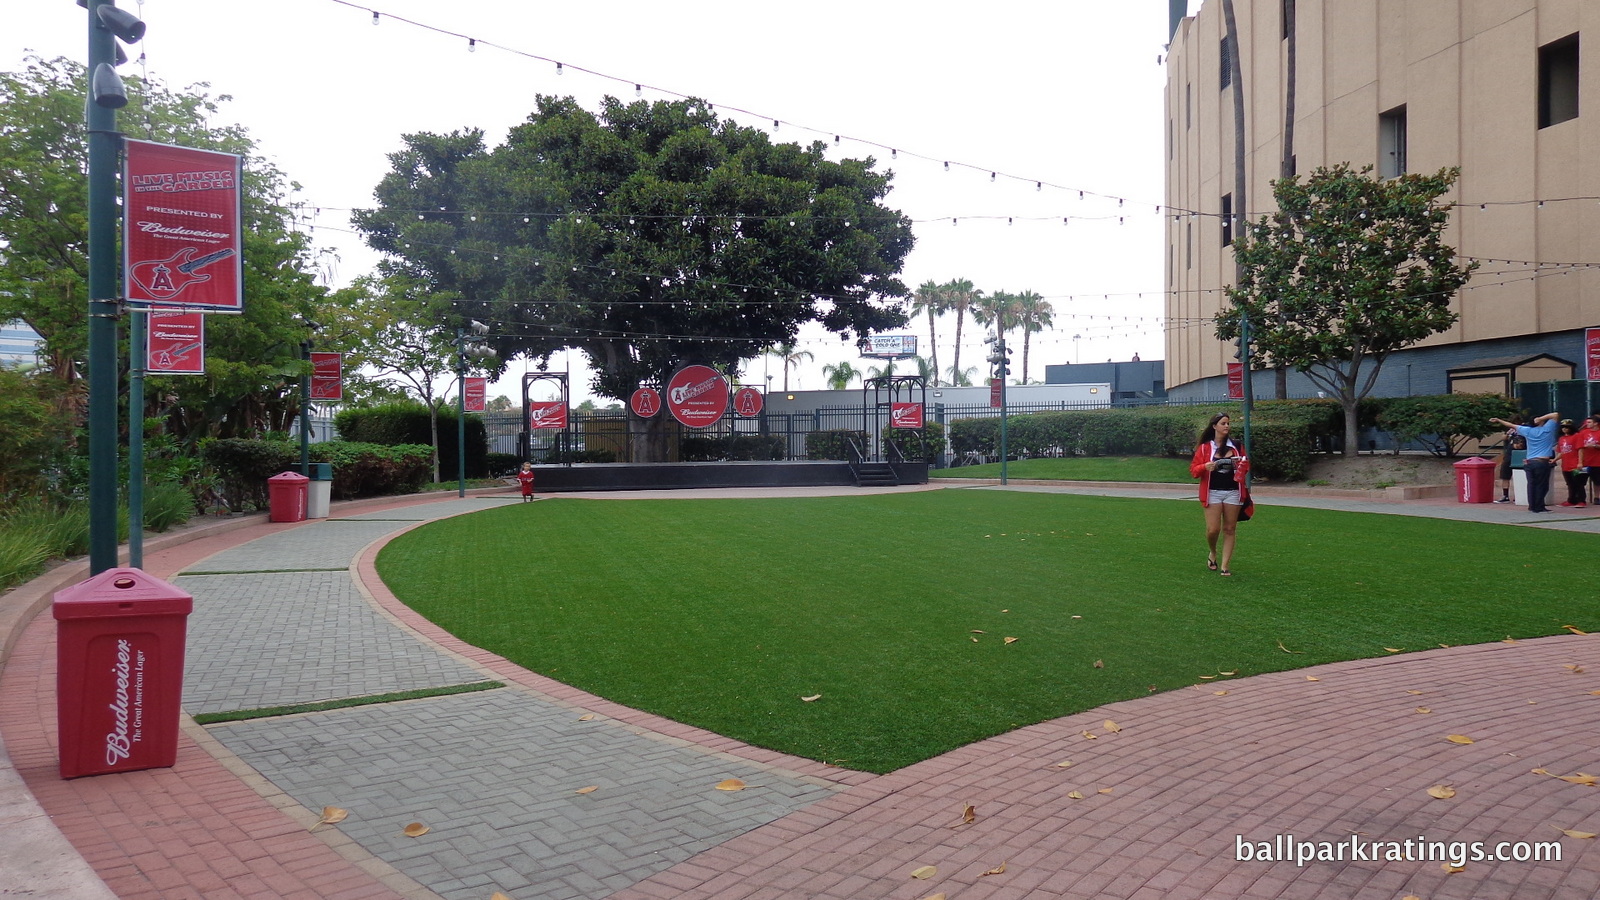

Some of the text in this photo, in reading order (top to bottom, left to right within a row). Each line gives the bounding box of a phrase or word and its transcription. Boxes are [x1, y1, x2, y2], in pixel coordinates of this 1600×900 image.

[132, 170, 233, 186] LIVE MUSIC
[146, 184, 161, 192] THE
[160, 179, 235, 193] GARDEN
[146, 206, 208, 218] PRESENTED
[136, 220, 230, 239] Budweiser
[106, 639, 132, 766] Budweiser
[132, 649, 146, 742] The Great American Lager
